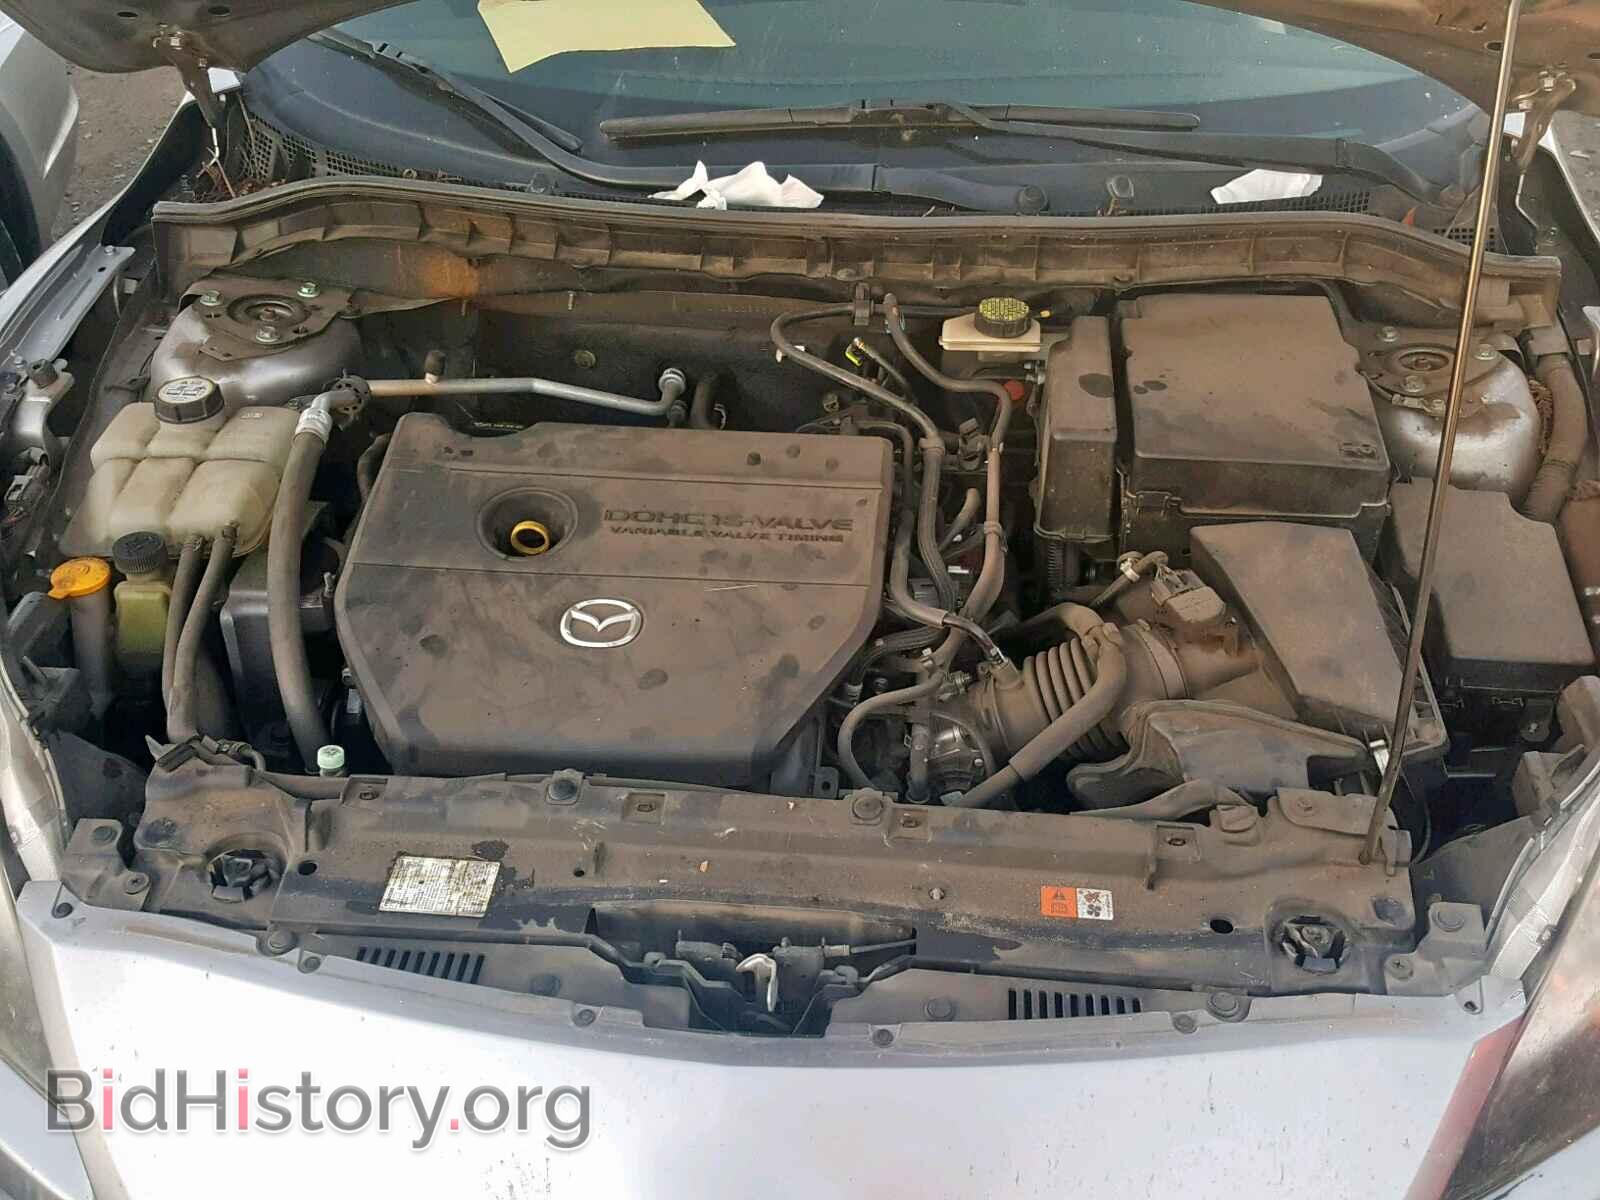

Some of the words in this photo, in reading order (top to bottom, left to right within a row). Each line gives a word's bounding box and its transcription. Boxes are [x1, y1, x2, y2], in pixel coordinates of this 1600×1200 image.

[604, 509, 704, 526] DOHC
[610, 526, 704, 538] VARIABLE
[710, 530, 770, 541] VALVE
[778, 533, 844, 543] TIMING
